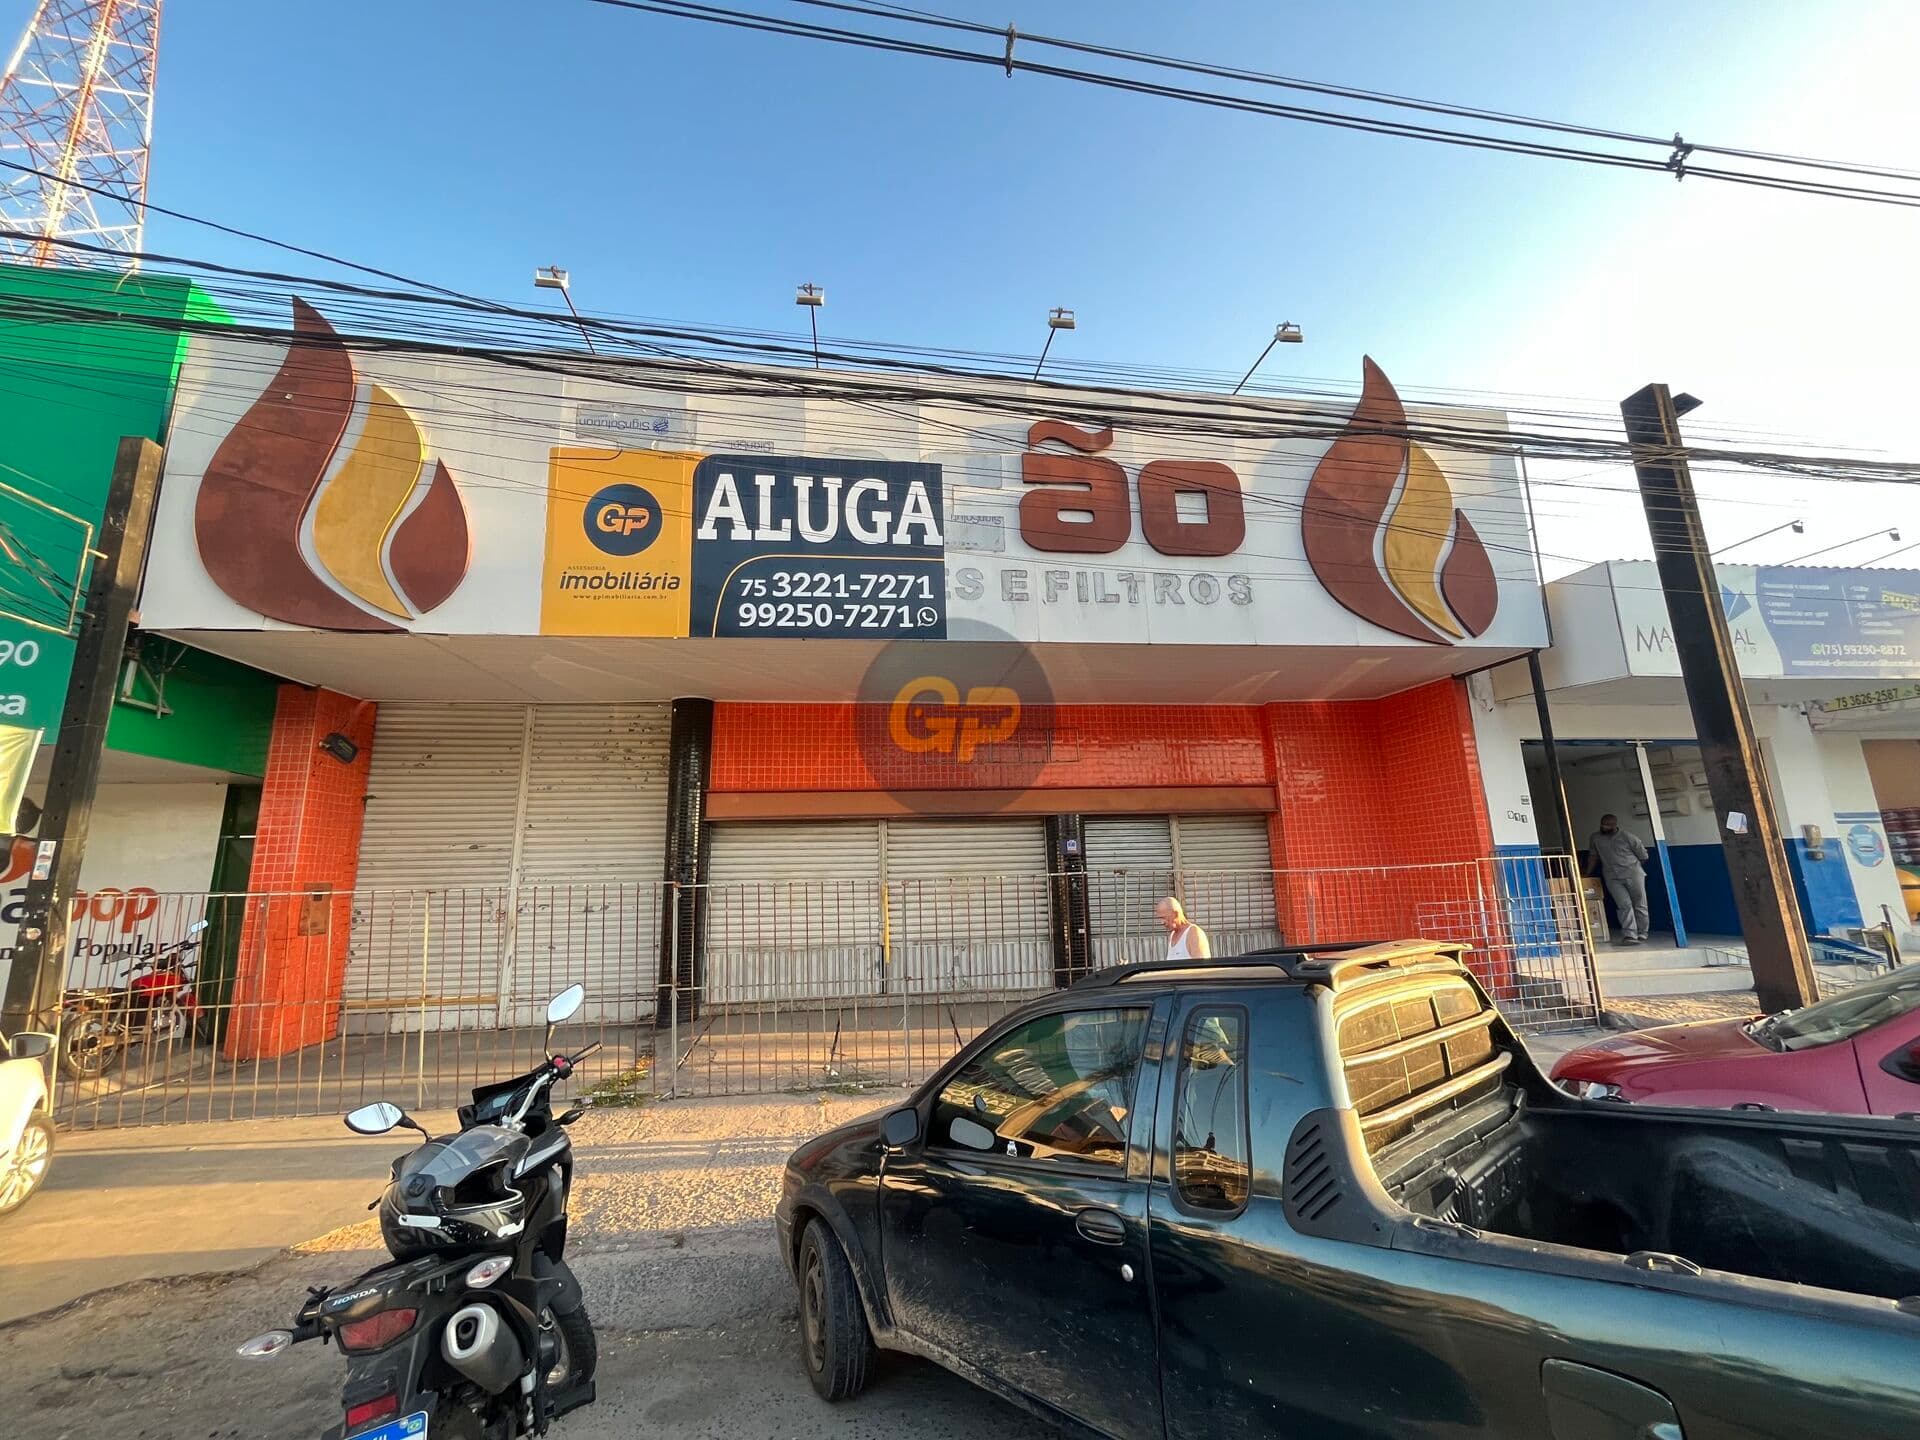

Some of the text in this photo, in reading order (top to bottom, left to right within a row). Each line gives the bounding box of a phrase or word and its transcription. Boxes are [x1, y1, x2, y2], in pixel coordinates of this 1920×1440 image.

[597, 503, 650, 536] GP
[697, 474, 944, 545] ALUGA
[559, 571, 682, 590] imobiliária
[740, 572, 934, 598] 75 3221-7271
[1000, 569, 1030, 602] E
[1045, 570, 1255, 605] FILTROS
[739, 603, 914, 628] 99250-7271
[73, 935, 169, 965] Popular
[332, 1288, 378, 1307] HONDA
